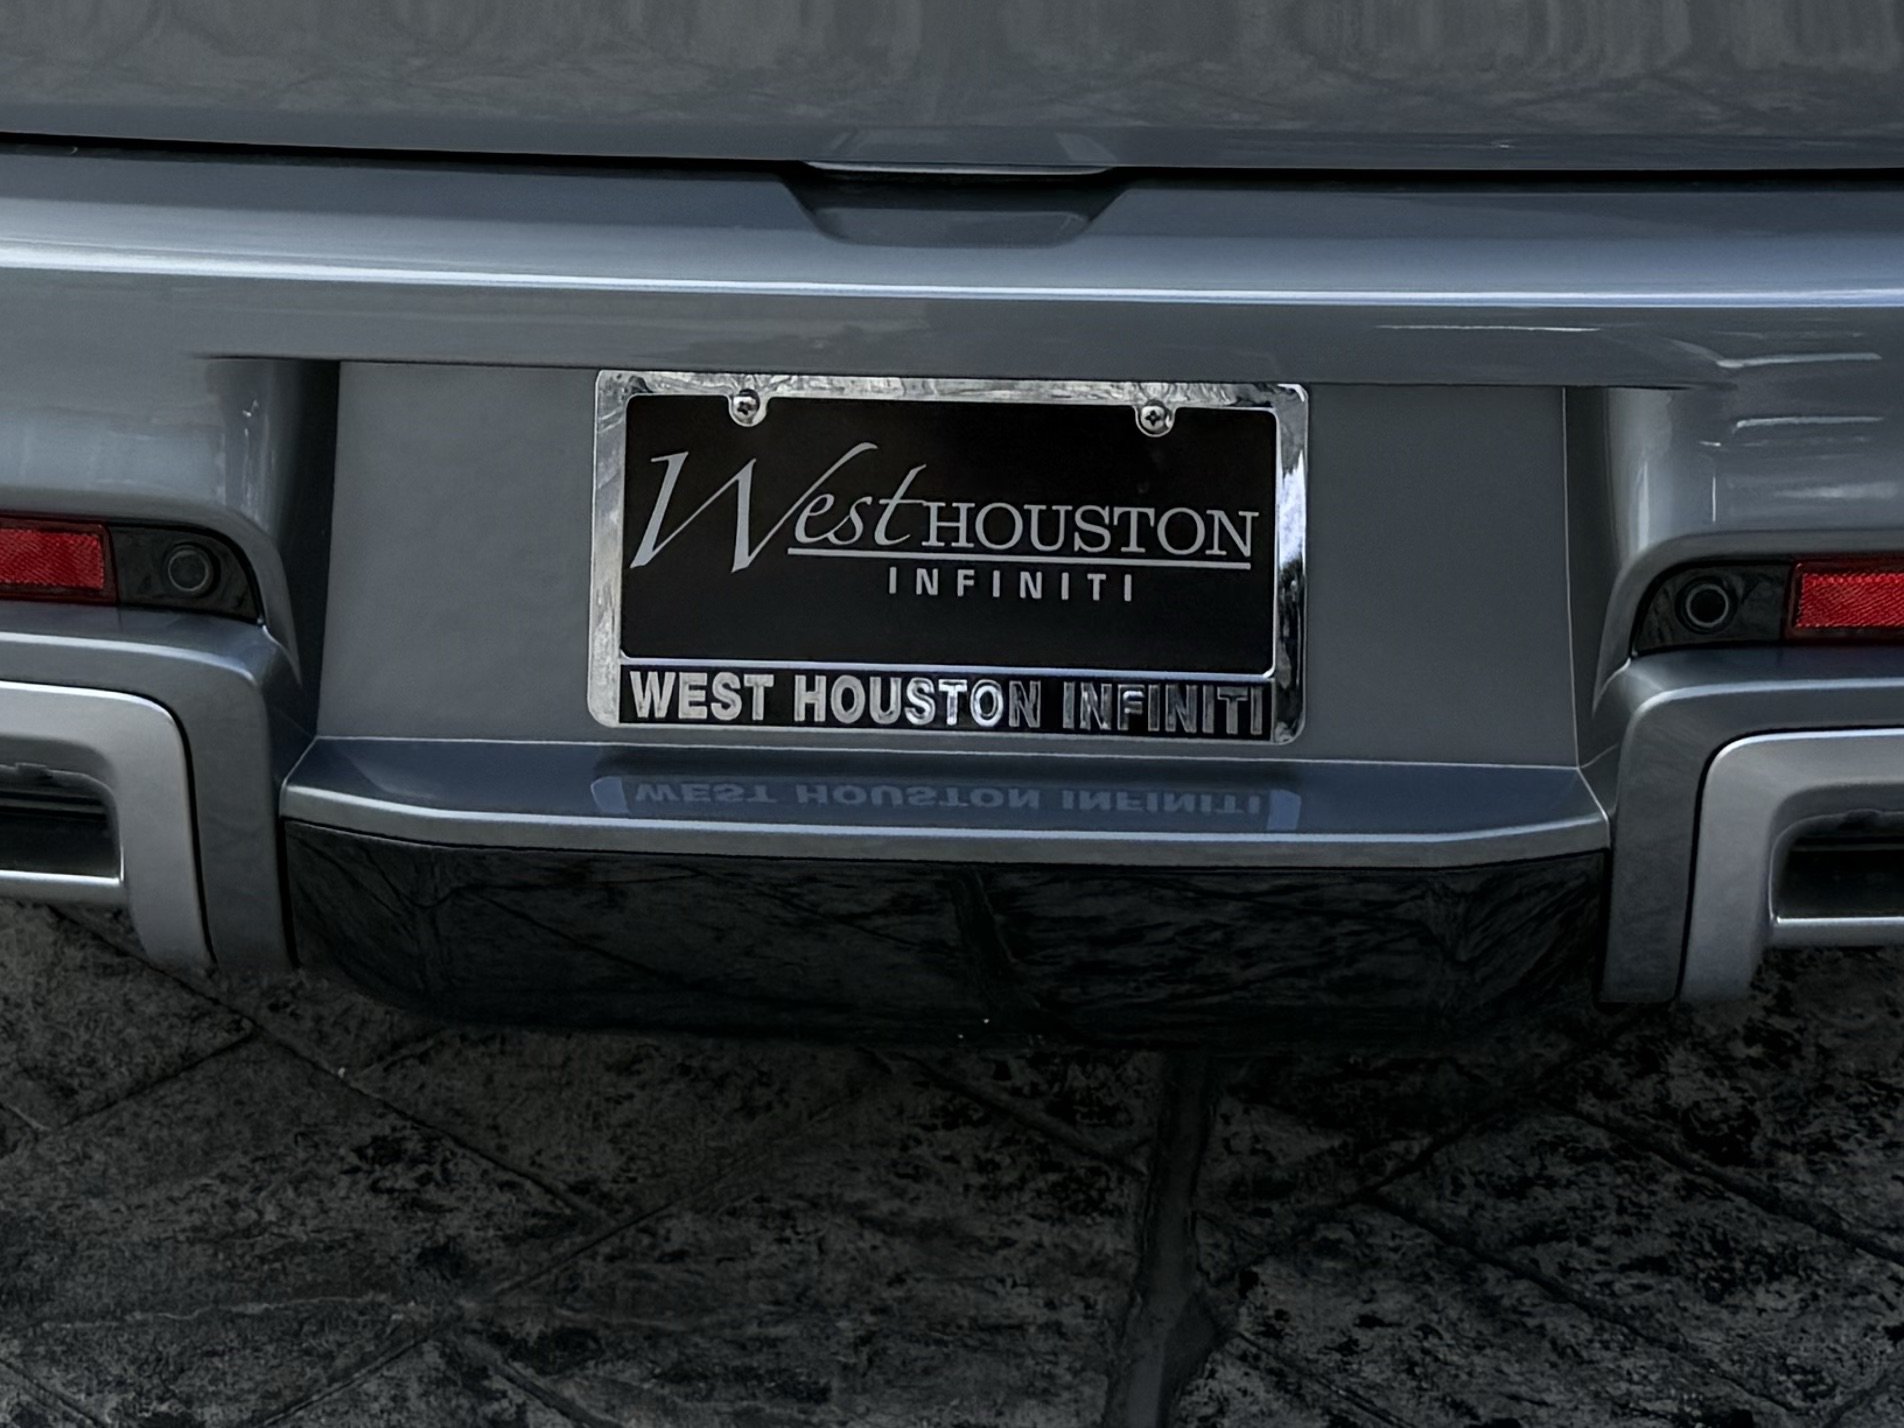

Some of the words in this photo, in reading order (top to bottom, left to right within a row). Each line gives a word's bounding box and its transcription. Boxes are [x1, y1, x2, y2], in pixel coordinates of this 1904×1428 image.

[629, 442, 927, 573] West
[922, 500, 1259, 558] HOUSTON
[888, 565, 1134, 603] INFINITI
[629, 670, 775, 721] WEST
[794, 674, 1042, 728] HOUSTON
[1062, 680, 1264, 736] INFINITI
